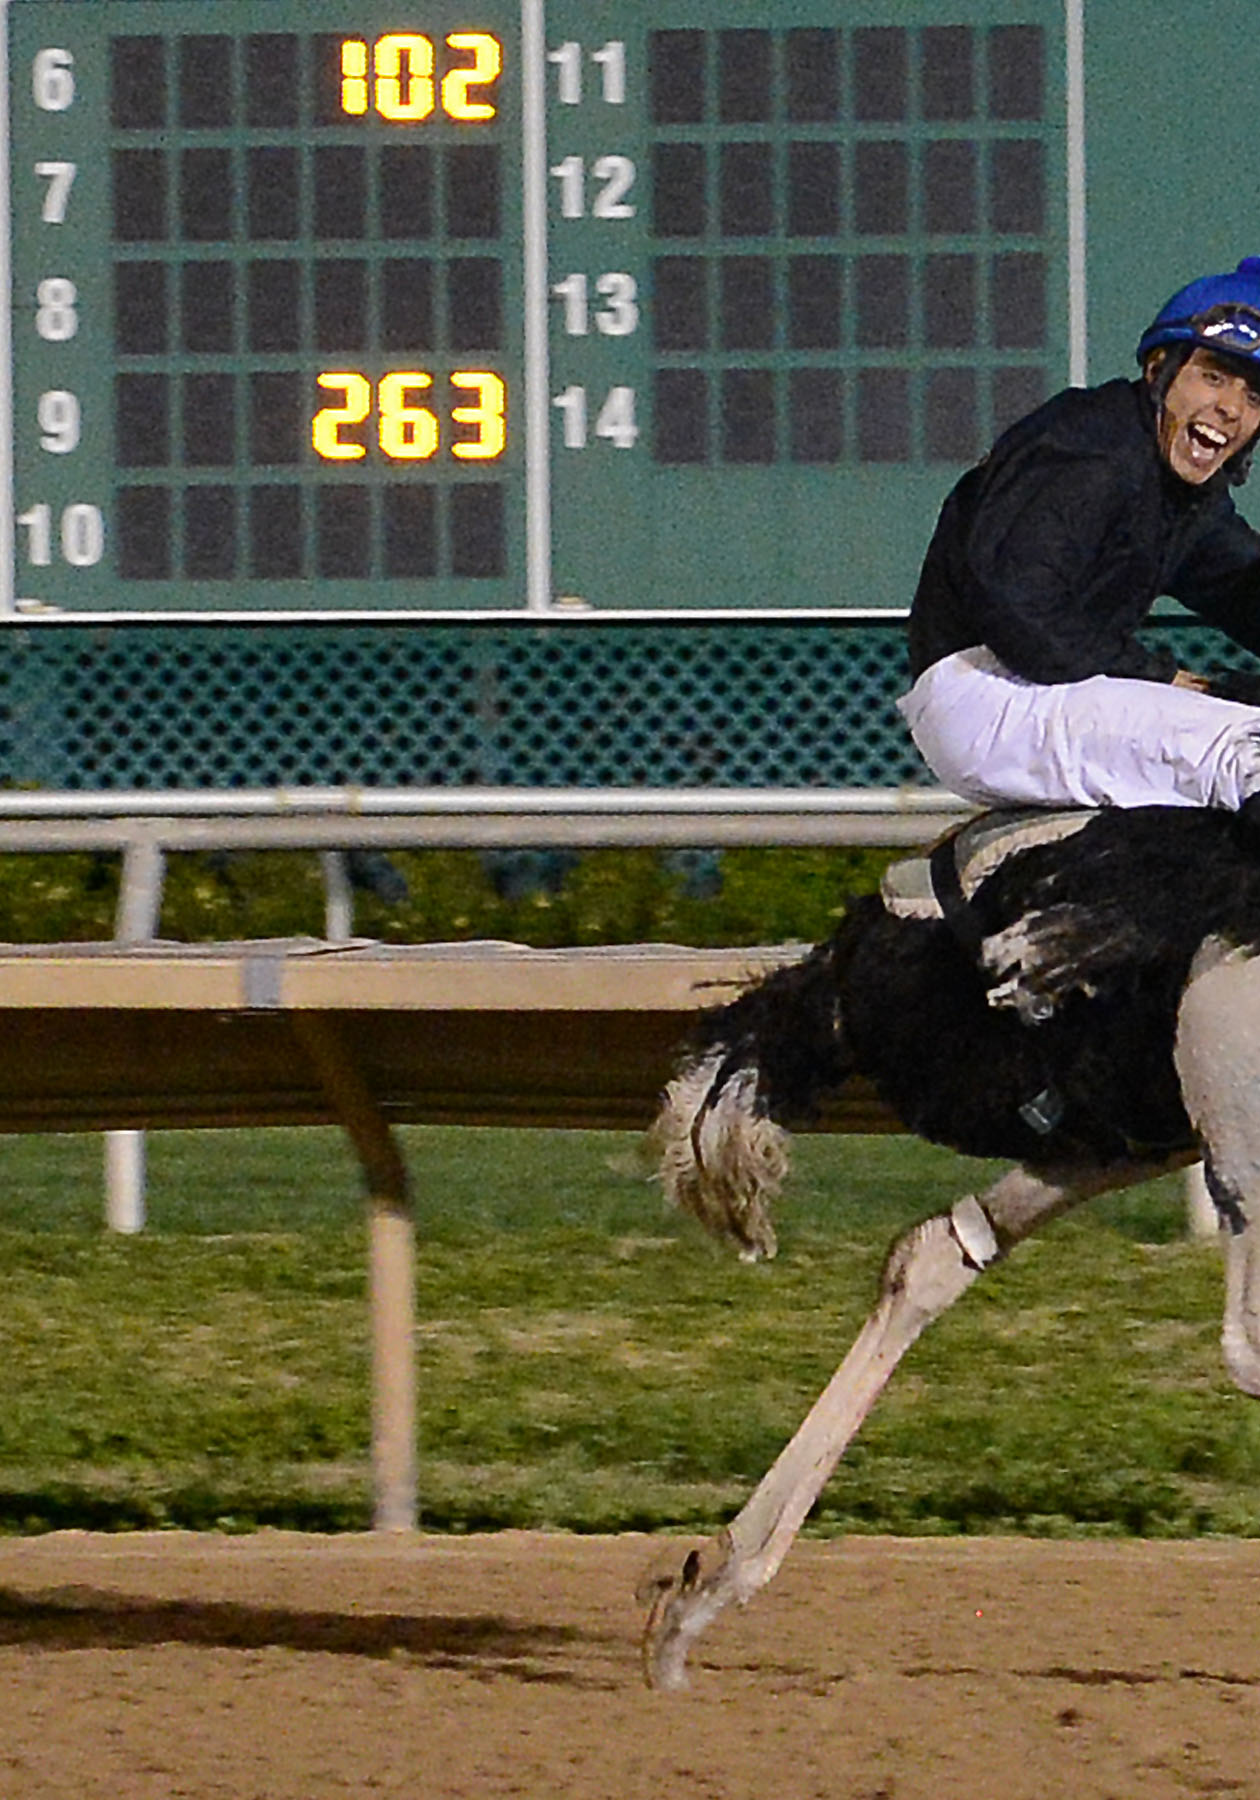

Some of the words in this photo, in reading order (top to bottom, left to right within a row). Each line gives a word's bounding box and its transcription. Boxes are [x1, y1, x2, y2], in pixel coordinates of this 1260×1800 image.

[32, 48, 75, 111] 6
[340, 33, 502, 121] 102
[548, 42, 627, 104] 11
[34, 162, 77, 224] 7
[551, 156, 637, 218] 12
[36, 278, 78, 341] 8
[552, 273, 640, 336] 13
[38, 390, 81, 454] 9
[312, 371, 506, 460] 263
[552, 386, 640, 448] 14
[17, 504, 104, 566] 10
